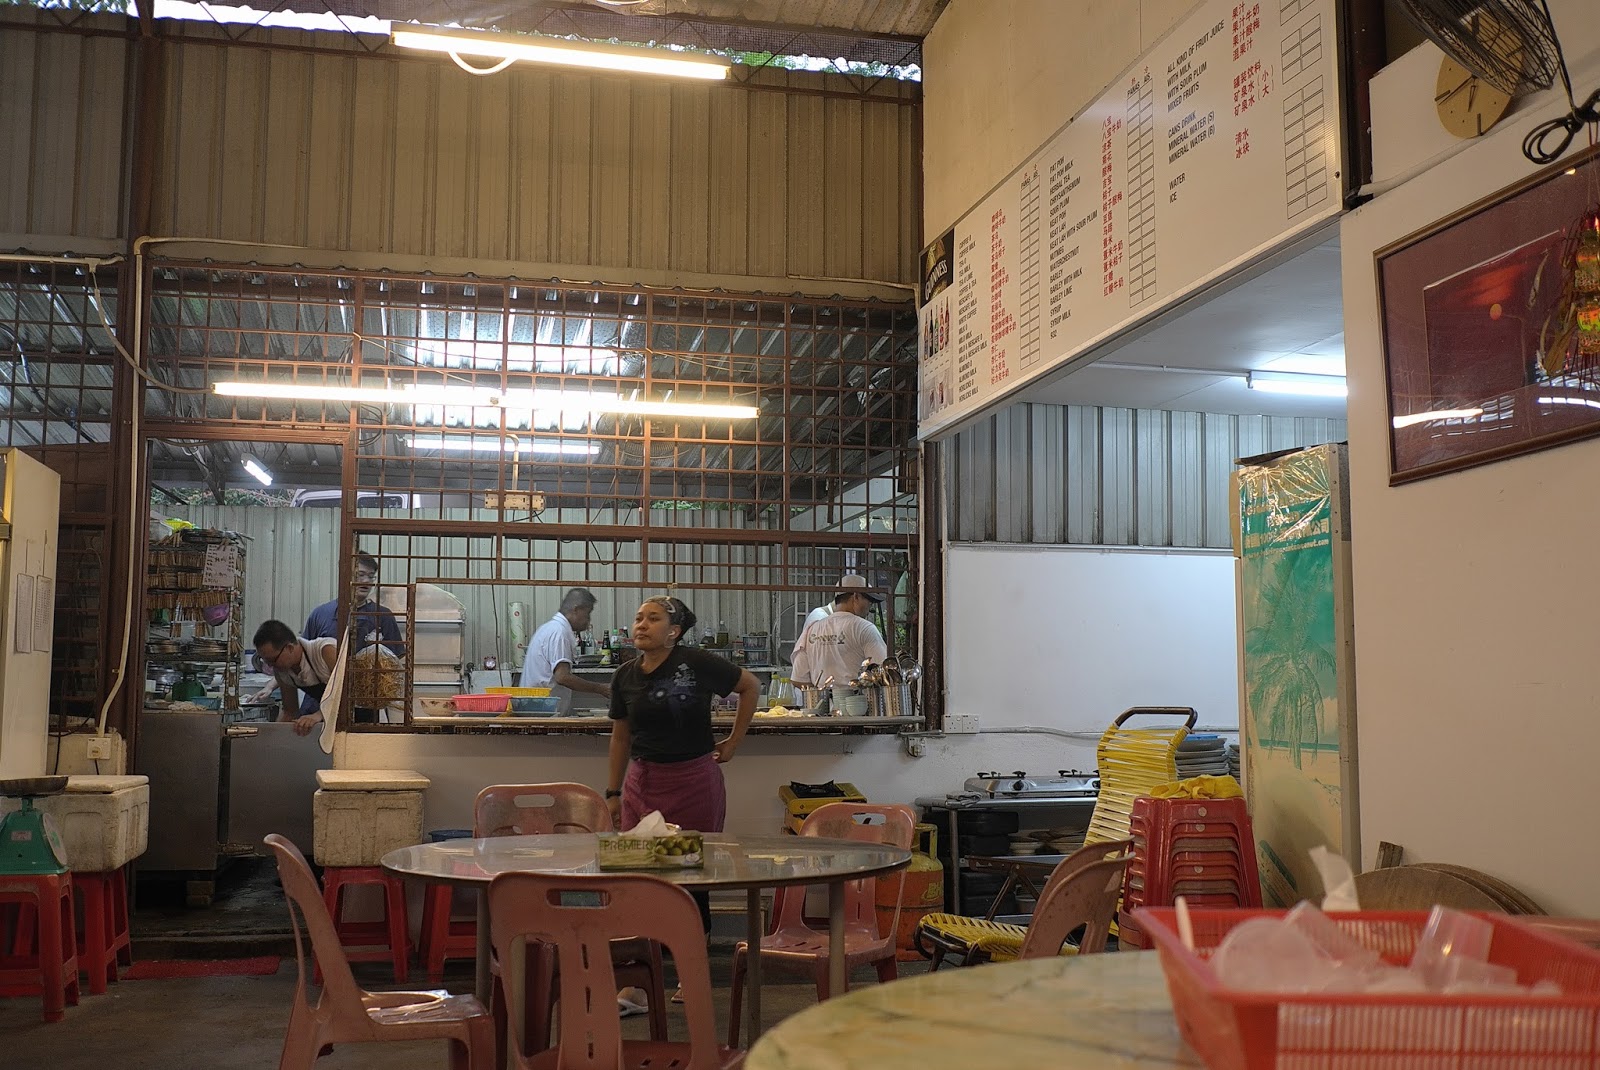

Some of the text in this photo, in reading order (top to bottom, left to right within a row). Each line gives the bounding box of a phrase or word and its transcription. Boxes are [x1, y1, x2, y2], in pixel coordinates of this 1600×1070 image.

[1232, 1, 1246, 20] 果汁
[1232, 4, 1260, 34] 果汁牛奶
[1233, 17, 1260, 48] 果汁酸梅
[1167, 20, 1224, 74] ALL KIND OF FRUIT JUICE
[1168, 61, 1192, 87] WITH MILK
[1168, 61, 1207, 100] WITH SOUR PLUM
[1234, 60, 1261, 90] 罐装饮料
[1128, 81, 1140, 97] PANAS
[1168, 81, 1200, 113] MIXED FRUITS
[1168, 111, 1196, 139] CANS DRINK
[1169, 129, 1189, 151] MINERAL
[1190, 116, 1206, 136] WATER
[1235, 127, 1249, 146] 清水
[1169, 143, 1189, 164] MINERAL
[1190, 130, 1207, 149] WATER
[1065, 160, 1074, 172] MILK
[1050, 180, 1063, 195] HERBAL
[1169, 173, 1186, 190] WATER
[1050, 197, 1070, 217] SOUR PLUM
[1067, 226, 1076, 238] WITH
[1076, 218, 1086, 231] SOUR
[1087, 210, 1098, 224] PLUM
[1050, 246, 1065, 261] NUTMEG
[1050, 269, 1063, 283] BARLEY
[1050, 267, 1083, 294] BARLEY WITH MILK
[1050, 286, 1073, 305] BARLEY LIME
[1050, 304, 1062, 317] SYRUP
[1050, 310, 1072, 328] SYRUP MILK
[604, 839, 650, 851] PREMIER
